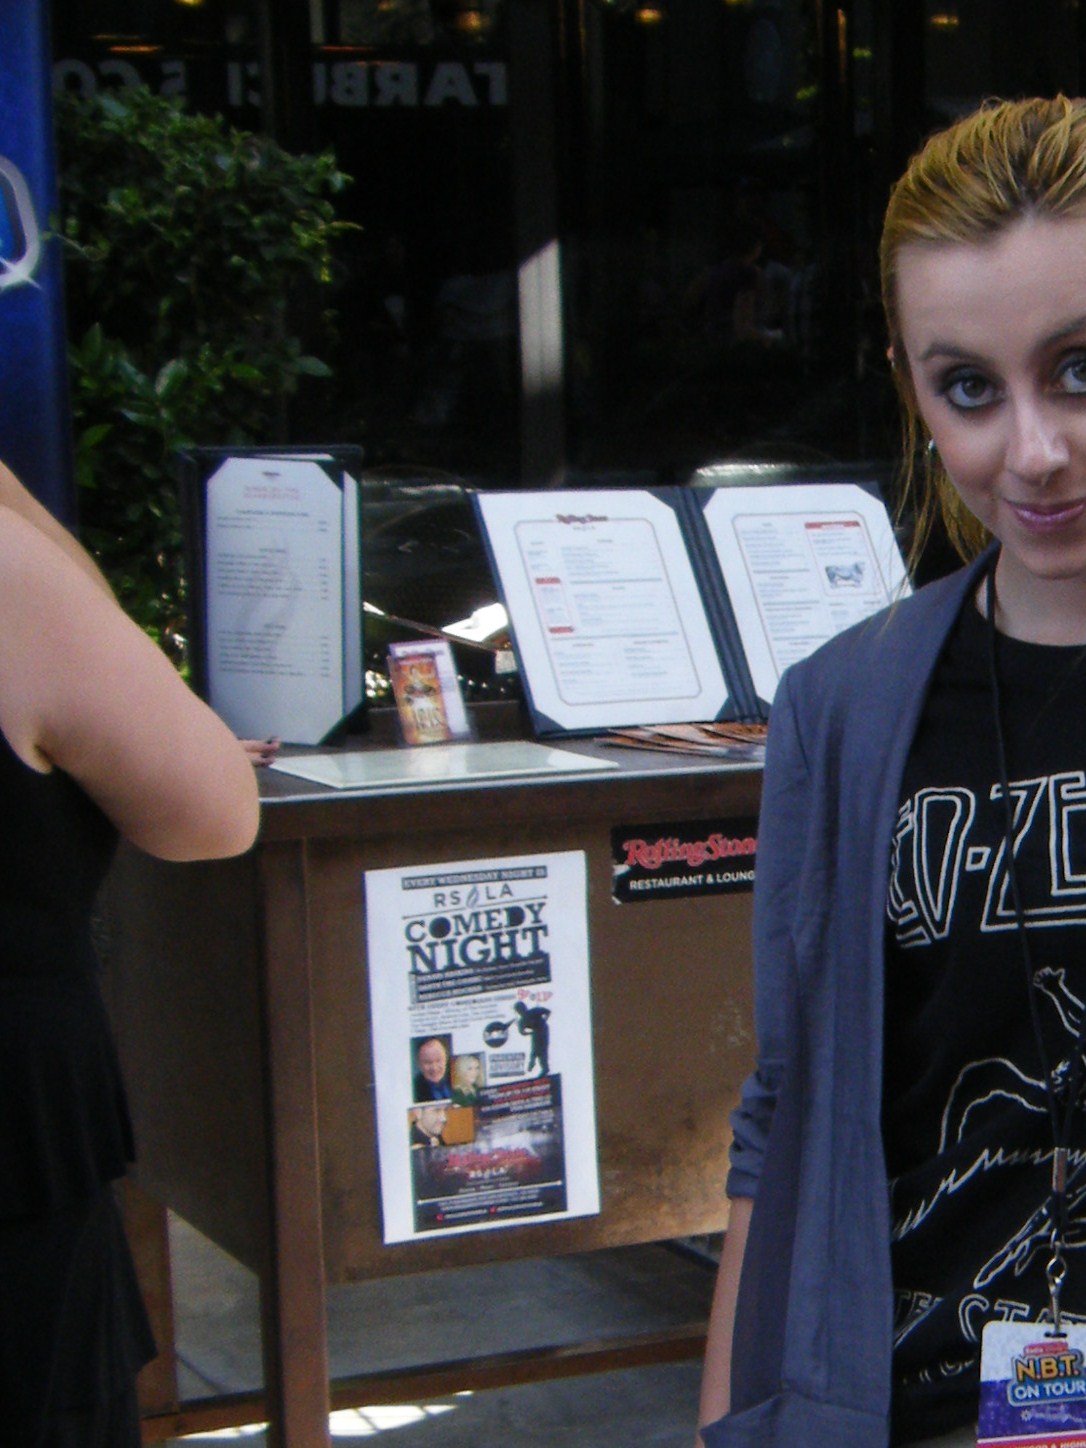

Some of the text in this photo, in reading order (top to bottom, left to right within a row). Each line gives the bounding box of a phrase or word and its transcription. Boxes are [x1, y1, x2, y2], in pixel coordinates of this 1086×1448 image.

[438, 872, 499, 886] WEDNESDAY
[501, 868, 534, 881] NIGHT
[629, 870, 756, 890] RESTAURANT & LOUNG
[433, 883, 514, 908] RS LA
[405, 902, 547, 943] COMEDY
[406, 925, 549, 974] NIGHT
[1014, 1380, 1086, 1400] ON TOUR
